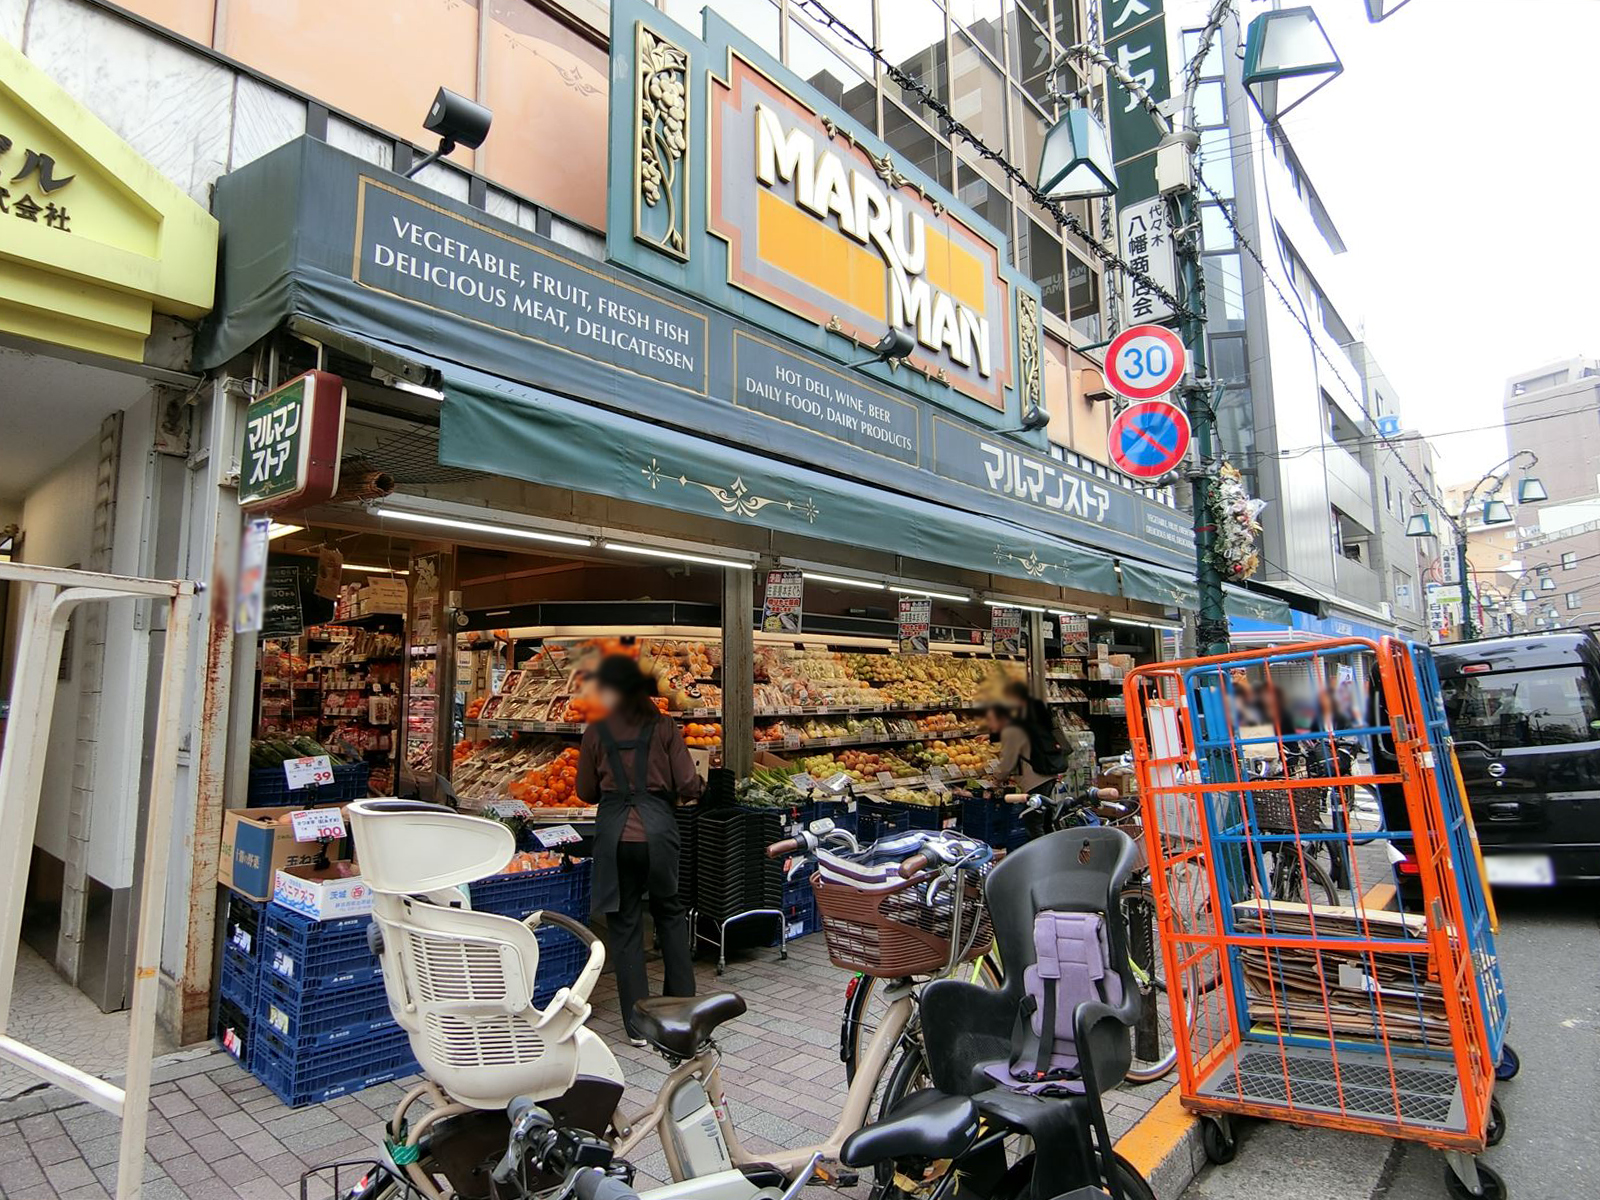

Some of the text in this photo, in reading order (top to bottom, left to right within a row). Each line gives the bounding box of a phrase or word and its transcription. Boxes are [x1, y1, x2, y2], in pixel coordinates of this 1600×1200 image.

[0, 134, 76, 195] ル
[755, 102, 926, 275] MARU
[1149, 204, 1165, 247] 代々木
[391, 215, 690, 346] VEGETABLE, FRUIT, FRESH FISH
[1128, 215, 1153, 318] 八幡商店会
[374, 243, 695, 373] DELICIOUS MEAT, DELICATESSEN
[887, 265, 991, 379] MAN
[1124, 345, 1167, 379] 30
[746, 377, 912, 451] DAILY FOOD, DAIRY PRODUCTS
[775, 365, 891, 424] HOT DELI, WINE, BEER
[248, 401, 301, 451] マルマン
[249, 440, 291, 485] ストア
[980, 442, 1110, 523] マルマンストア
[314, 771, 331, 782] 39
[317, 826, 342, 837] 100
